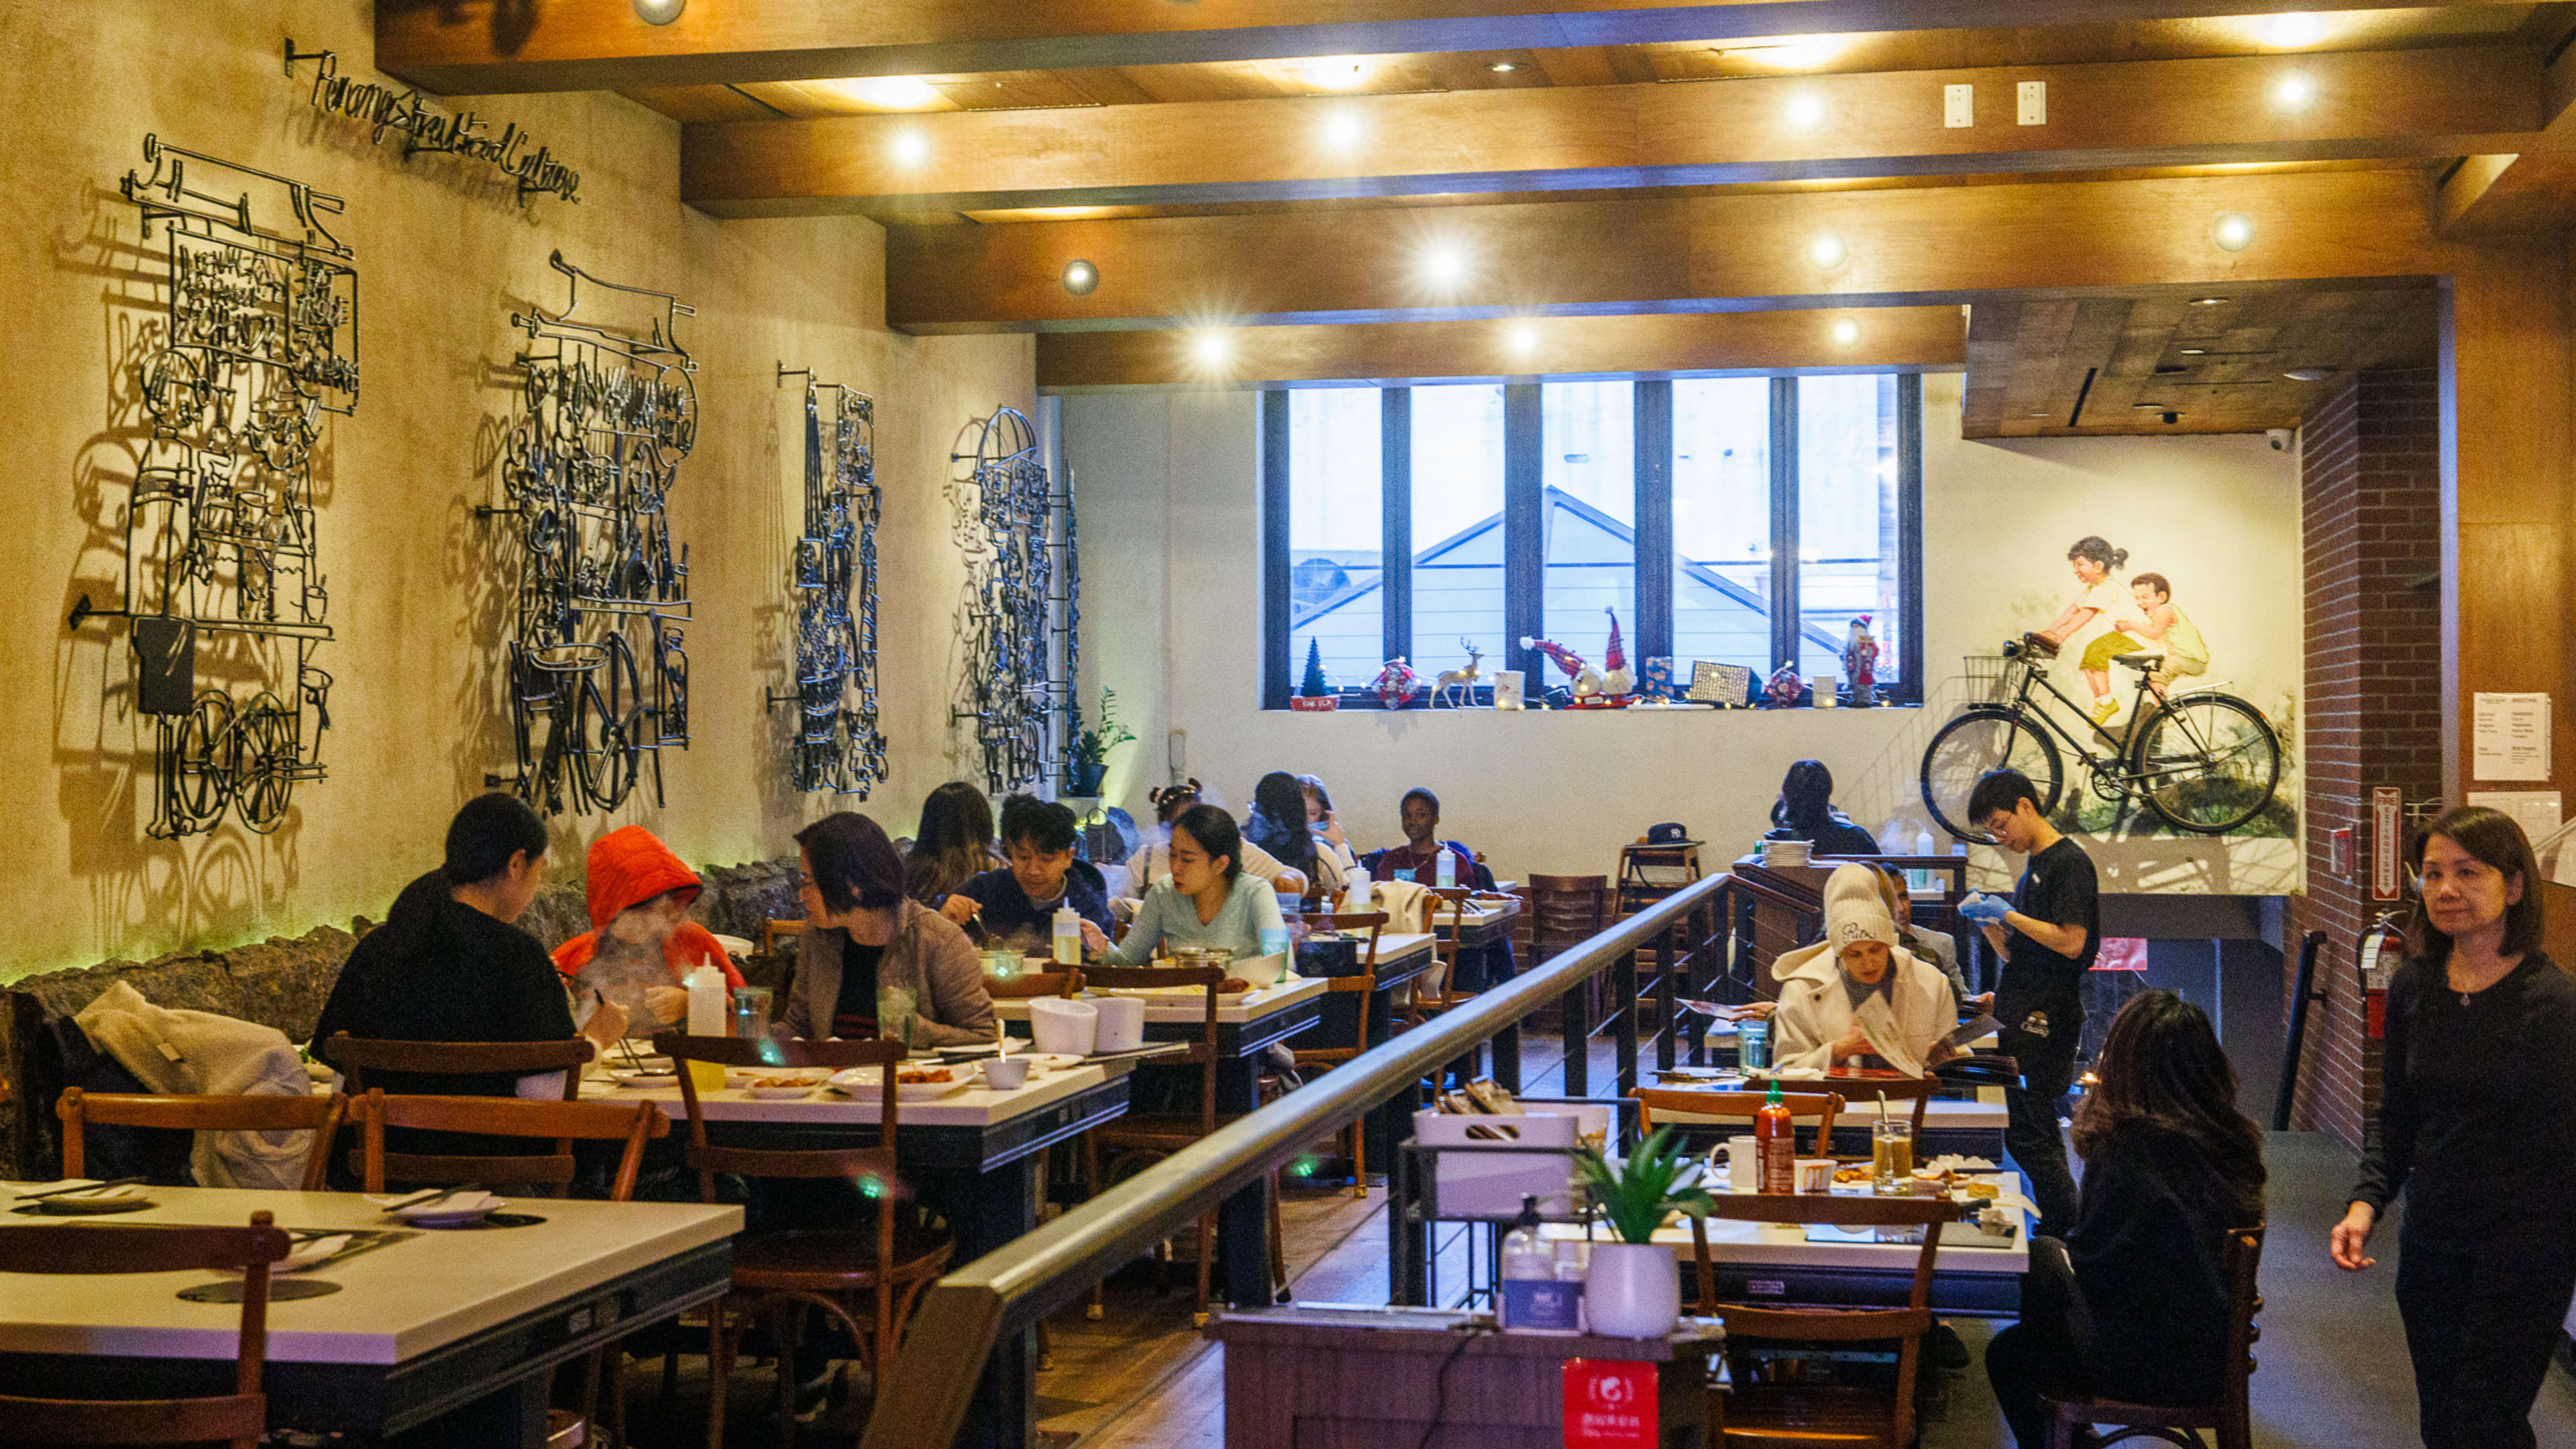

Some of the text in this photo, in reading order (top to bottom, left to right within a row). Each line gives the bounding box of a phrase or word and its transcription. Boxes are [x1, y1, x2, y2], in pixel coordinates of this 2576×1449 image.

[311, 50, 396, 145] Penang
[2377, 796, 2398, 805] FIRE
[2382, 806, 2390, 888] EXTINGUISHER
